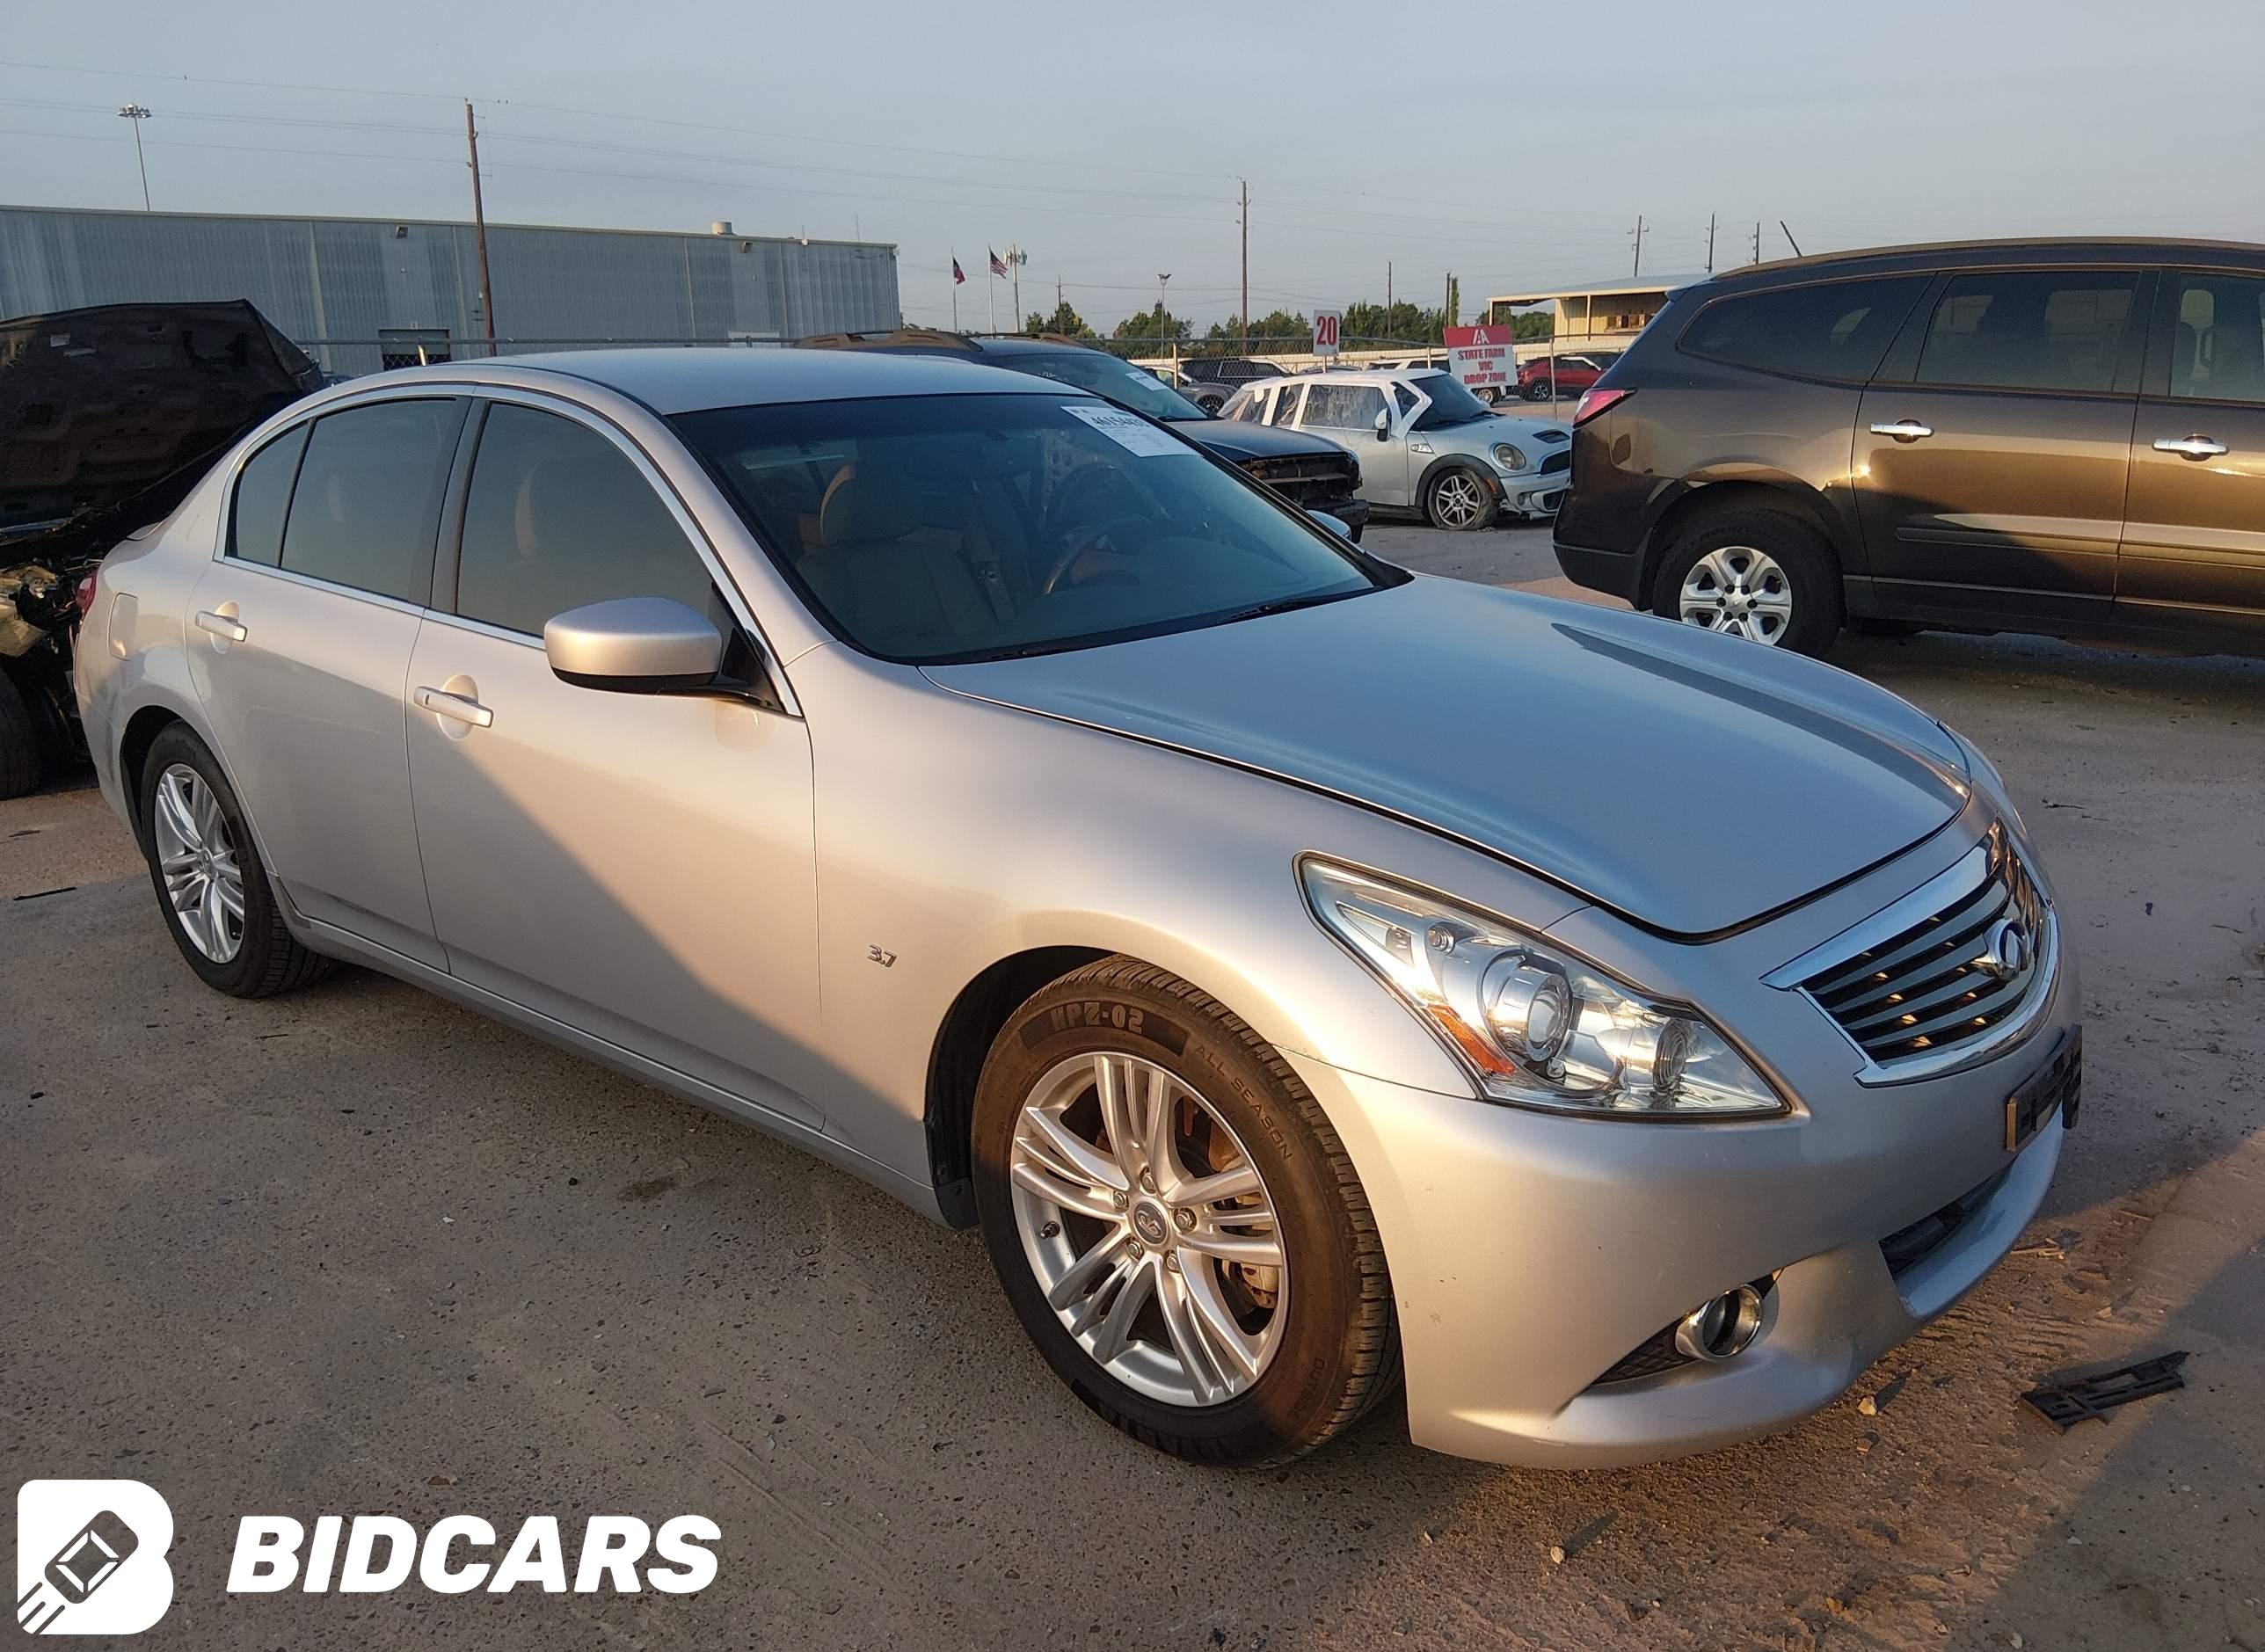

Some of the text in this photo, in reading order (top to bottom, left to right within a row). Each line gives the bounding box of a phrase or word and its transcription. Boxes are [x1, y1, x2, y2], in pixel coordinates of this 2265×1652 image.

[1316, 316, 1336, 345] 20
[1458, 348, 1505, 360] STATE FARM
[1478, 360, 1493, 371] VIC
[1464, 372, 1506, 384] DROP ZONE
[1050, 1001, 1145, 1035] HPZ-02
[1194, 1044, 1293, 1161] ALL SEASON
